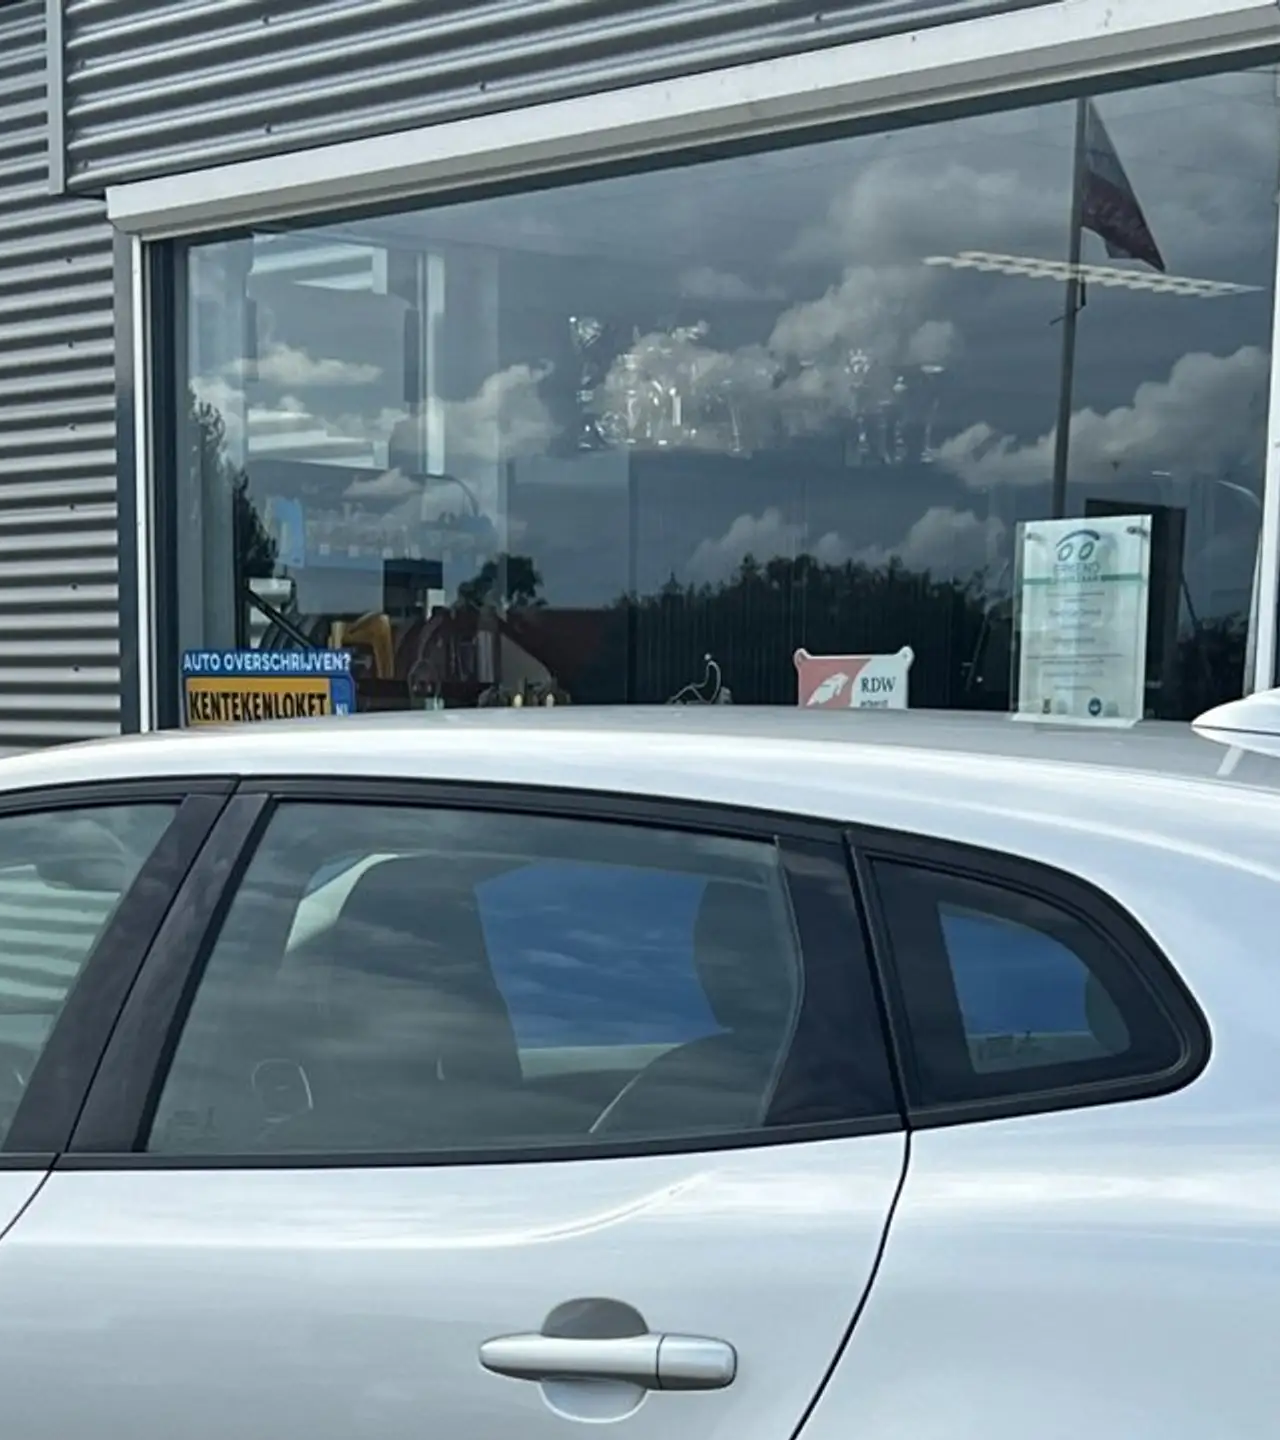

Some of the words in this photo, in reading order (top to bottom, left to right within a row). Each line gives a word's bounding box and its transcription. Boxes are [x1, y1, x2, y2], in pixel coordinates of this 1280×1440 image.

[183, 653, 220, 672] AUTO
[223, 653, 352, 672] OVERSCHRIJVEN?
[860, 675, 896, 693] RDW
[188, 690, 328, 722] KENTEKENLOKET
